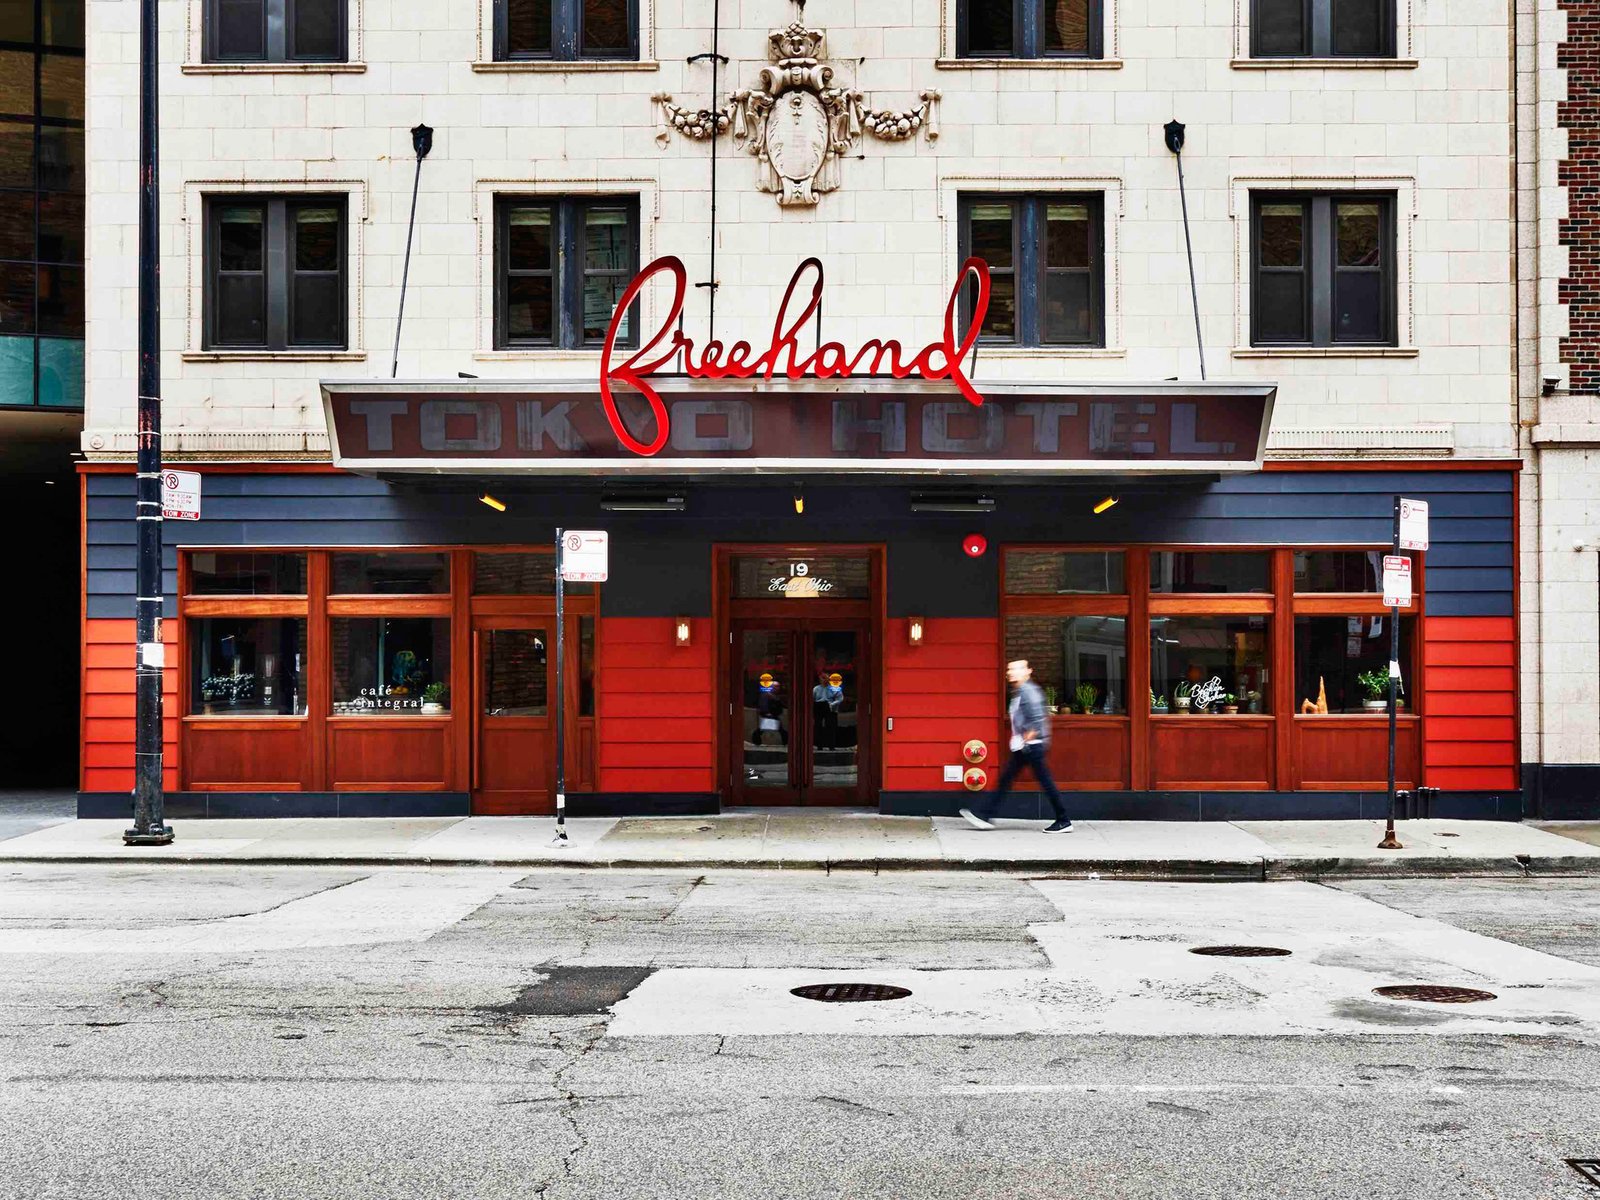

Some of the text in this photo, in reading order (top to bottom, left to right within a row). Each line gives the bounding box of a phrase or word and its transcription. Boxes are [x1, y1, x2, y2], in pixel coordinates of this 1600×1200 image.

[831, 401, 1236, 454] HOTEL
[165, 510, 197, 519] TOW ZONE
[565, 572, 603, 580] TOW ZONE
[790, 562, 809, 577] 19
[768, 577, 833, 592] East Ohio
[361, 684, 392, 696] café
[361, 696, 424, 711] integral
